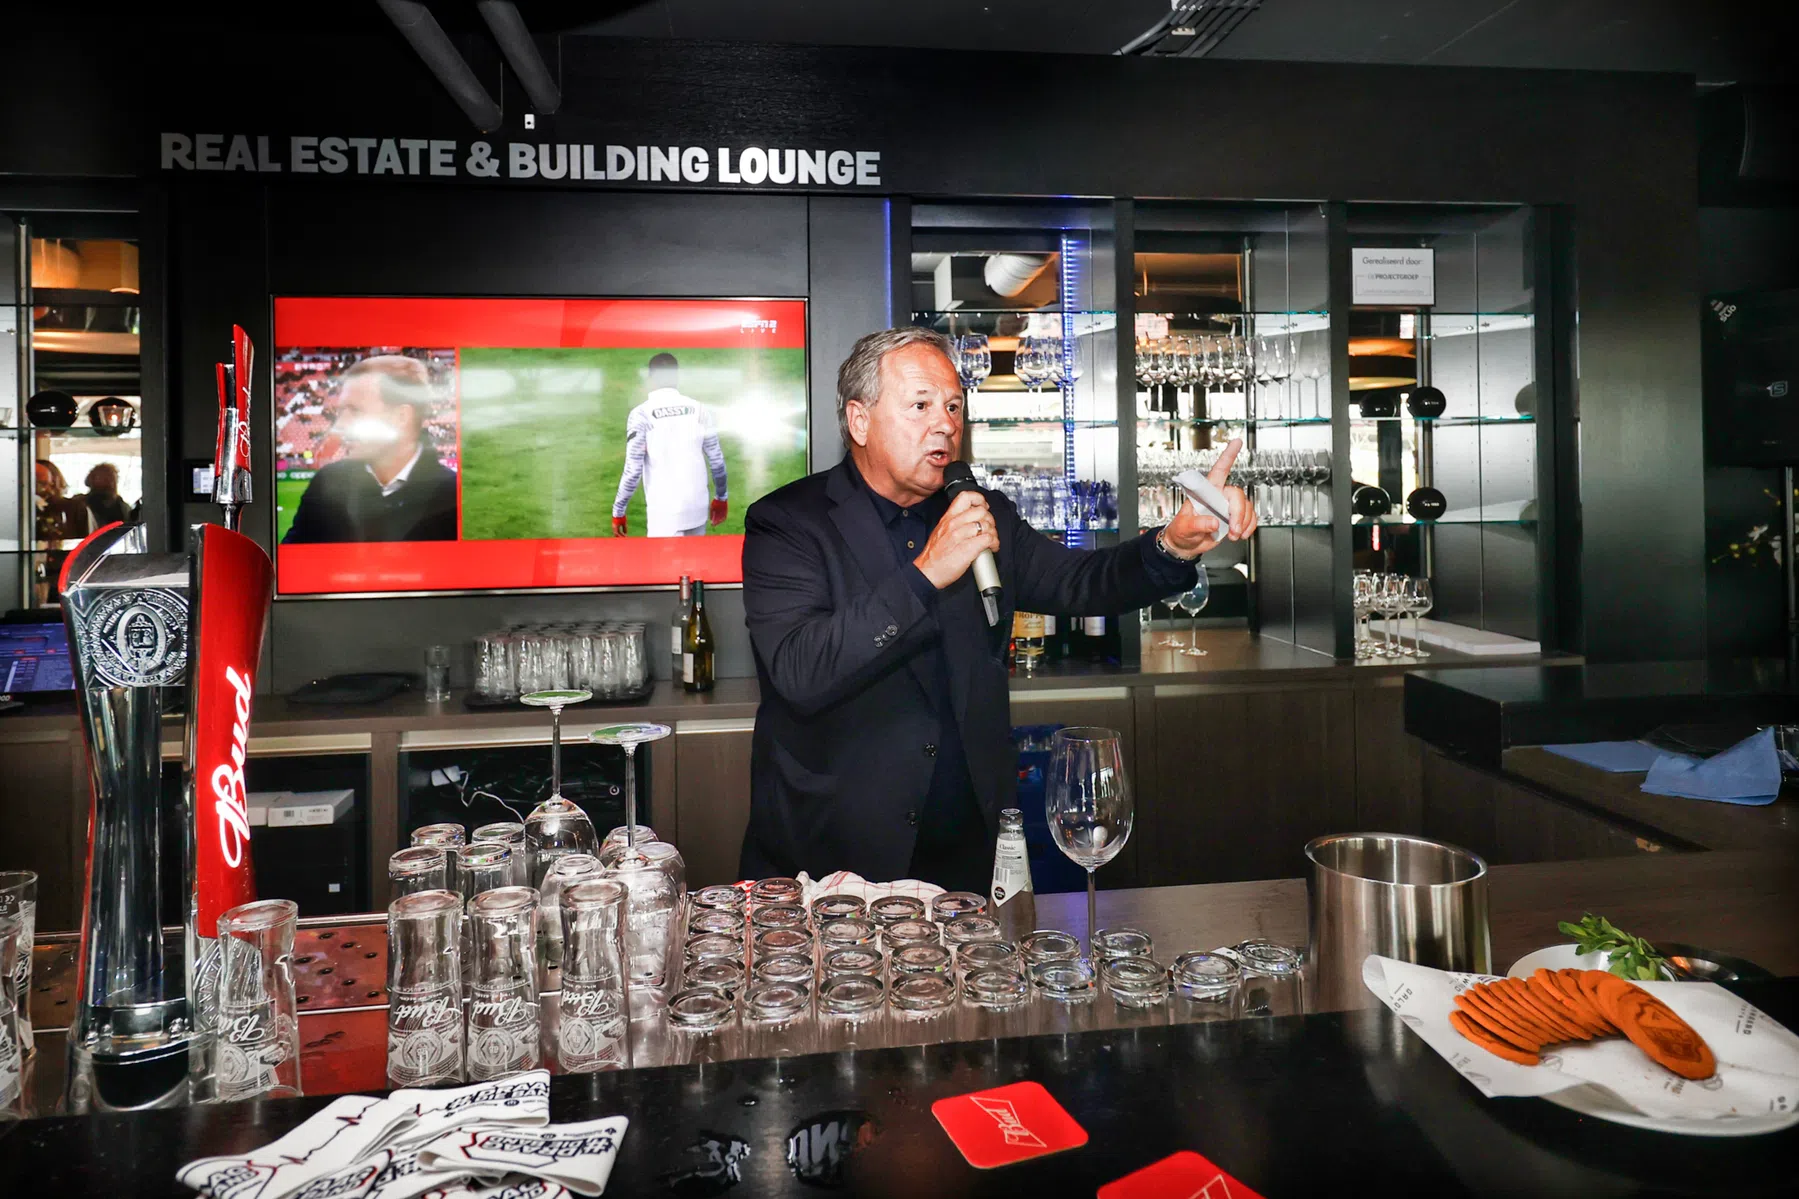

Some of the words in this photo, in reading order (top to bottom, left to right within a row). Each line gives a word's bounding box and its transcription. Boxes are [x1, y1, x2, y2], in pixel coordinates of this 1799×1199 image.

[160, 132, 282, 172] REAL
[290, 136, 457, 176] ESTATE
[465, 141, 500, 178] &
[508, 142, 710, 182] BUILDING
[718, 146, 881, 186] LOUNGE
[653, 406, 684, 418] DASSY
[212, 665, 252, 868] Bud
[394, 996, 456, 1028] Bud
[472, 996, 527, 1026] Bud
[560, 989, 609, 1017] Bud
[989, 1107, 1030, 1144] Bud
